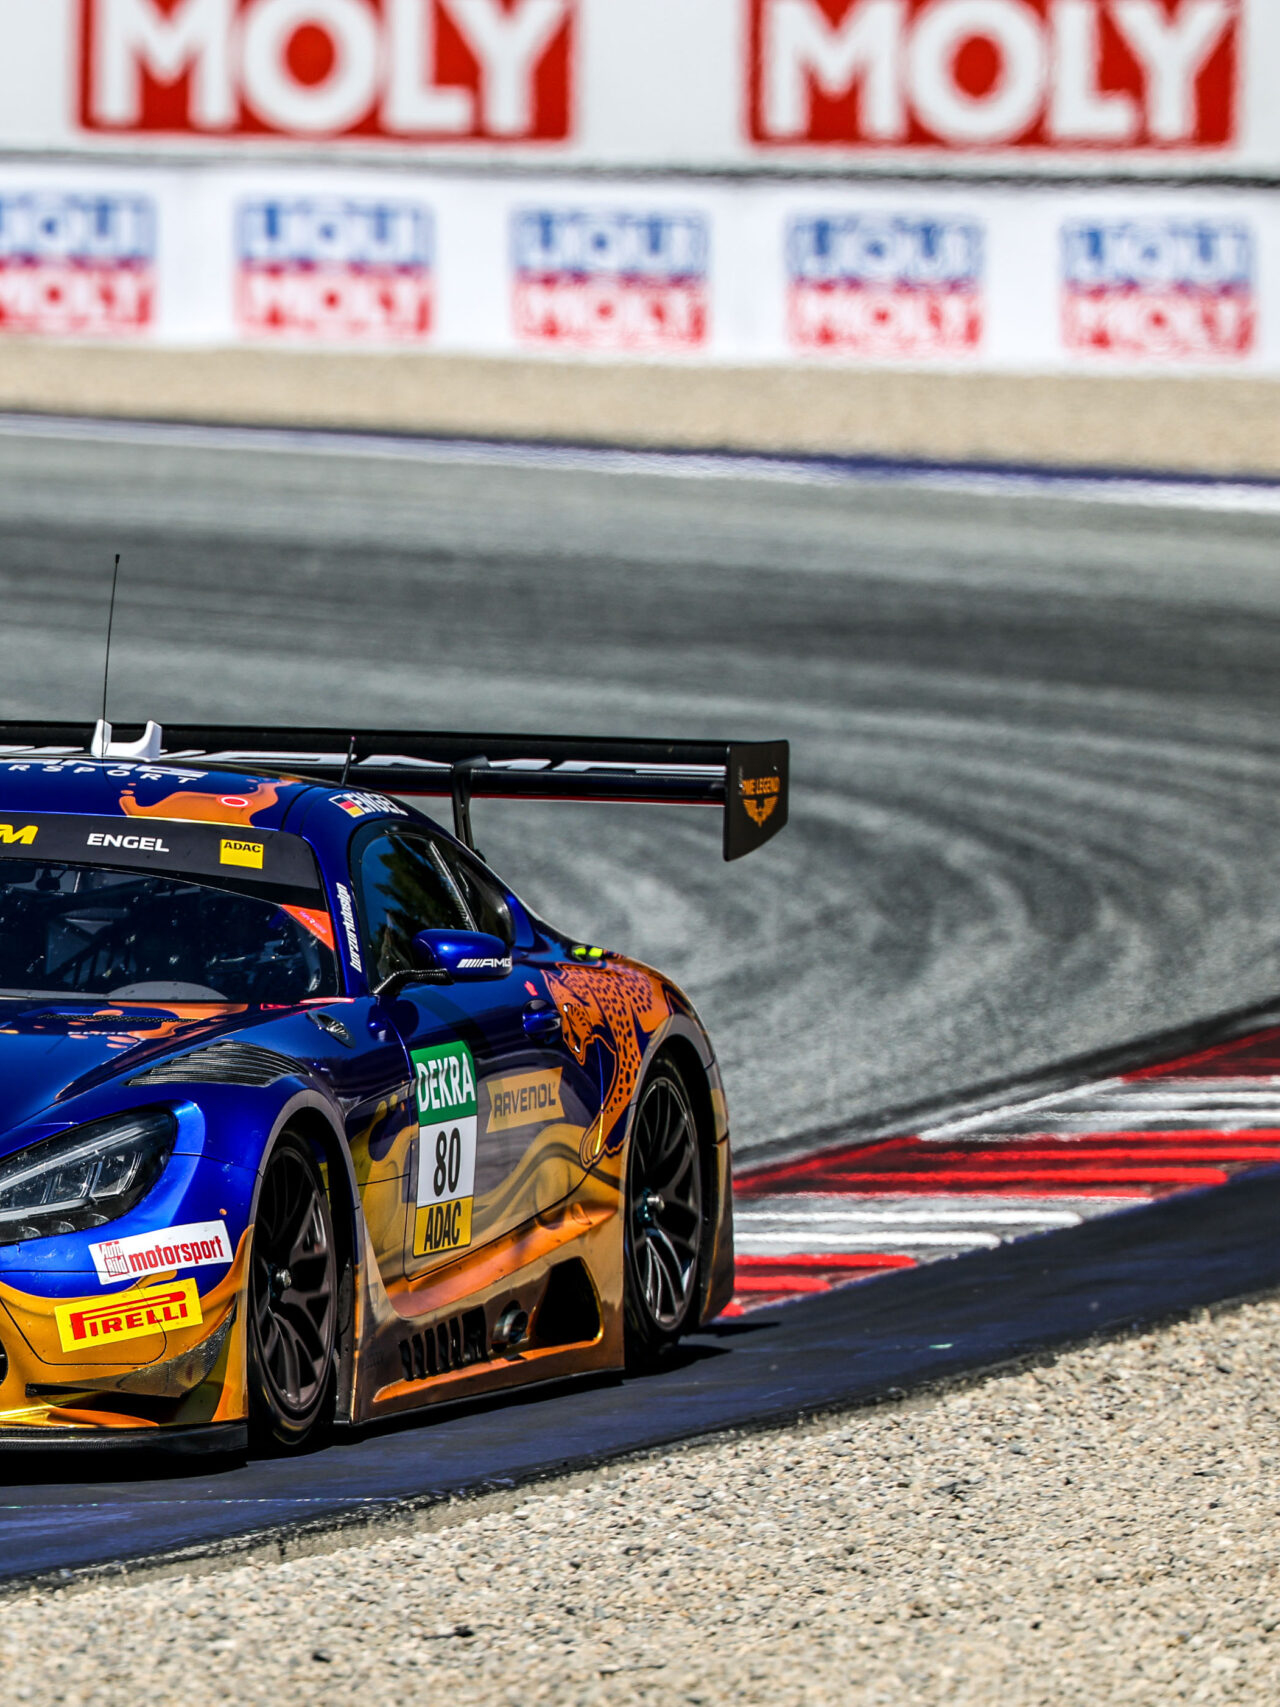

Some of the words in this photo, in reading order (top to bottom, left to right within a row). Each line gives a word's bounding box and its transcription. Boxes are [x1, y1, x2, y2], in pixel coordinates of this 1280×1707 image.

[92, 0, 568, 135] MOLY
[763, 0, 1236, 142] MOLY
[86, 833, 170, 852] ENGEL
[223, 840, 262, 853] ADAC
[416, 1052, 476, 1112] DEKRA
[493, 1083, 557, 1119] RAVENOL
[433, 1127, 462, 1197] 80
[423, 1201, 462, 1252] ADAC
[128, 1236, 224, 1272] motorsport
[69, 1291, 189, 1341] PIRELLI
